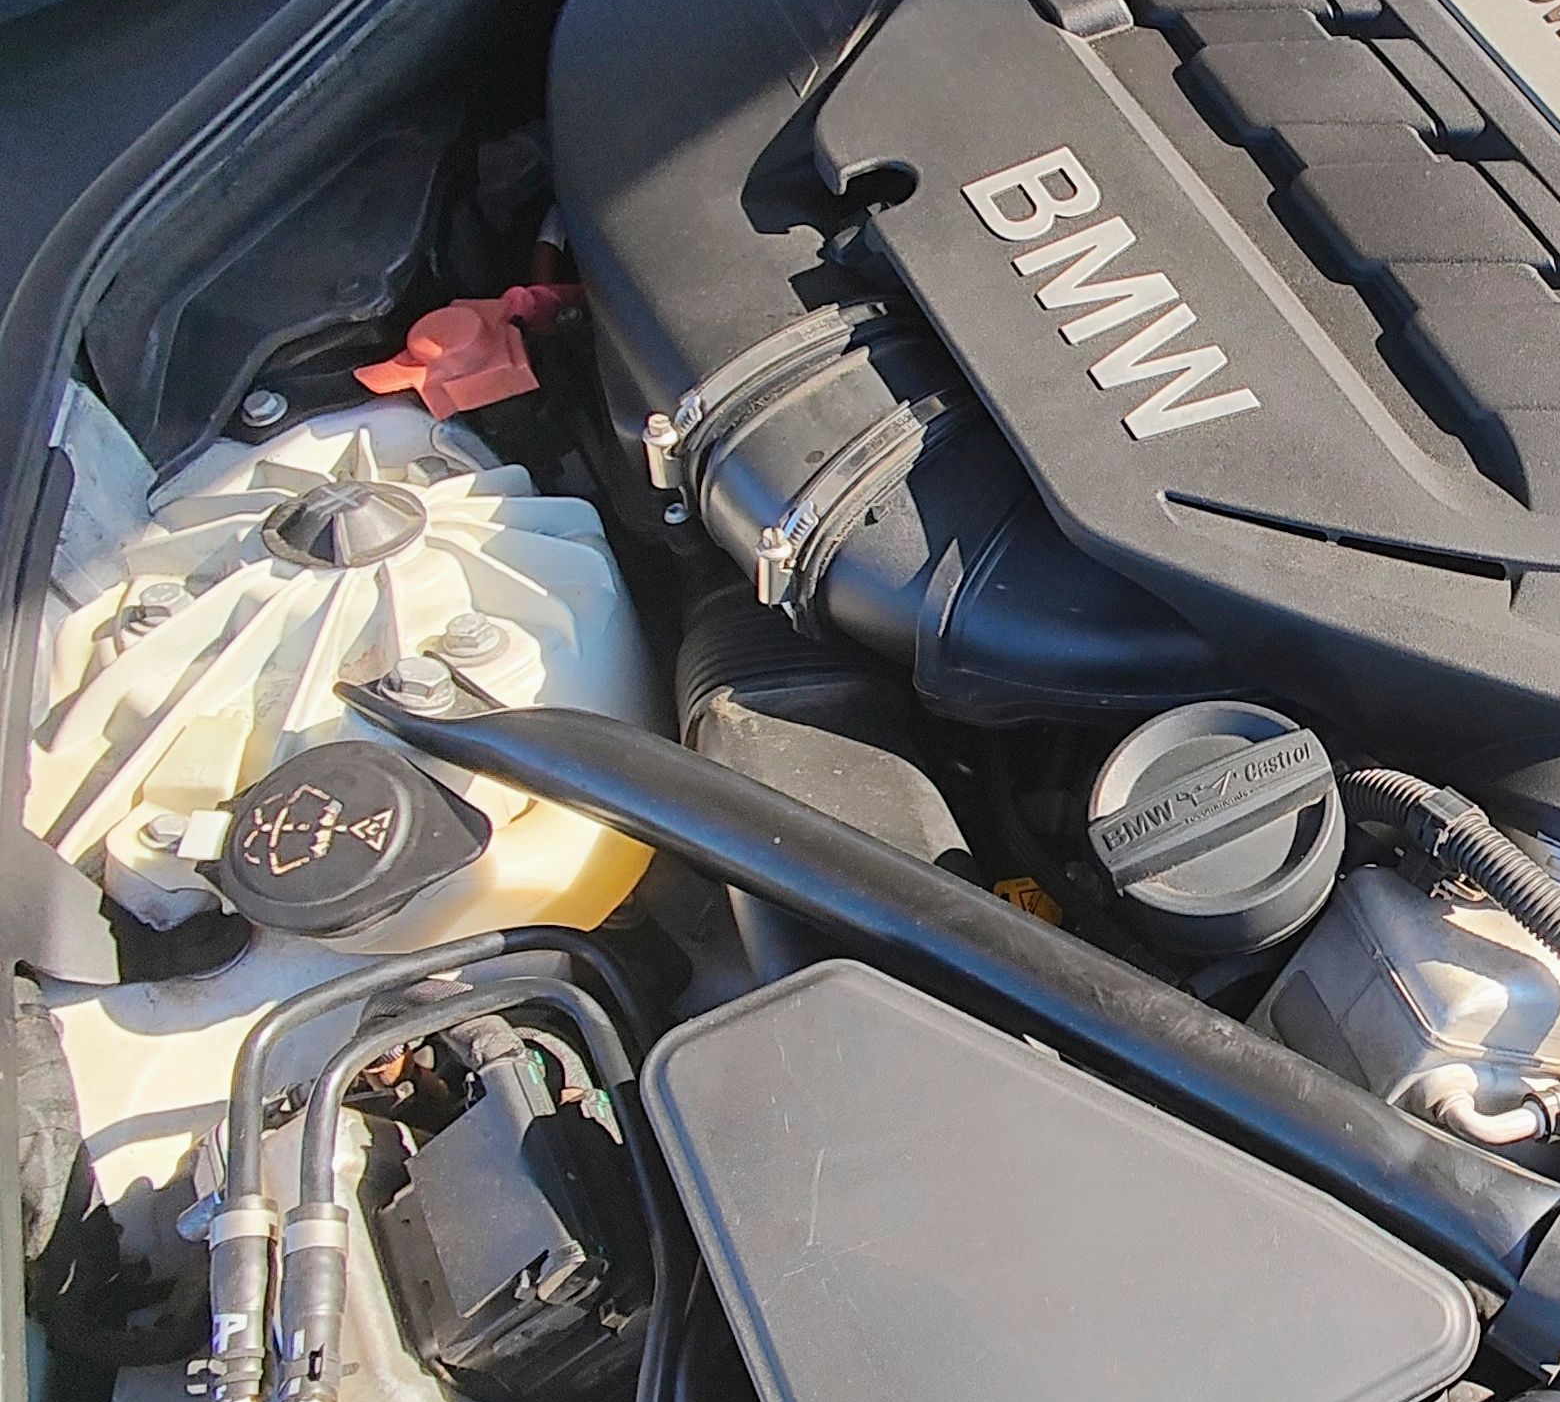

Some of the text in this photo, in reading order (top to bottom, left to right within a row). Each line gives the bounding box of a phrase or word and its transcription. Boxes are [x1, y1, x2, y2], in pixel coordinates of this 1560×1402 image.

[960, 146, 1262, 441] BMW
[1101, 742, 1312, 852] BMW Castrol
